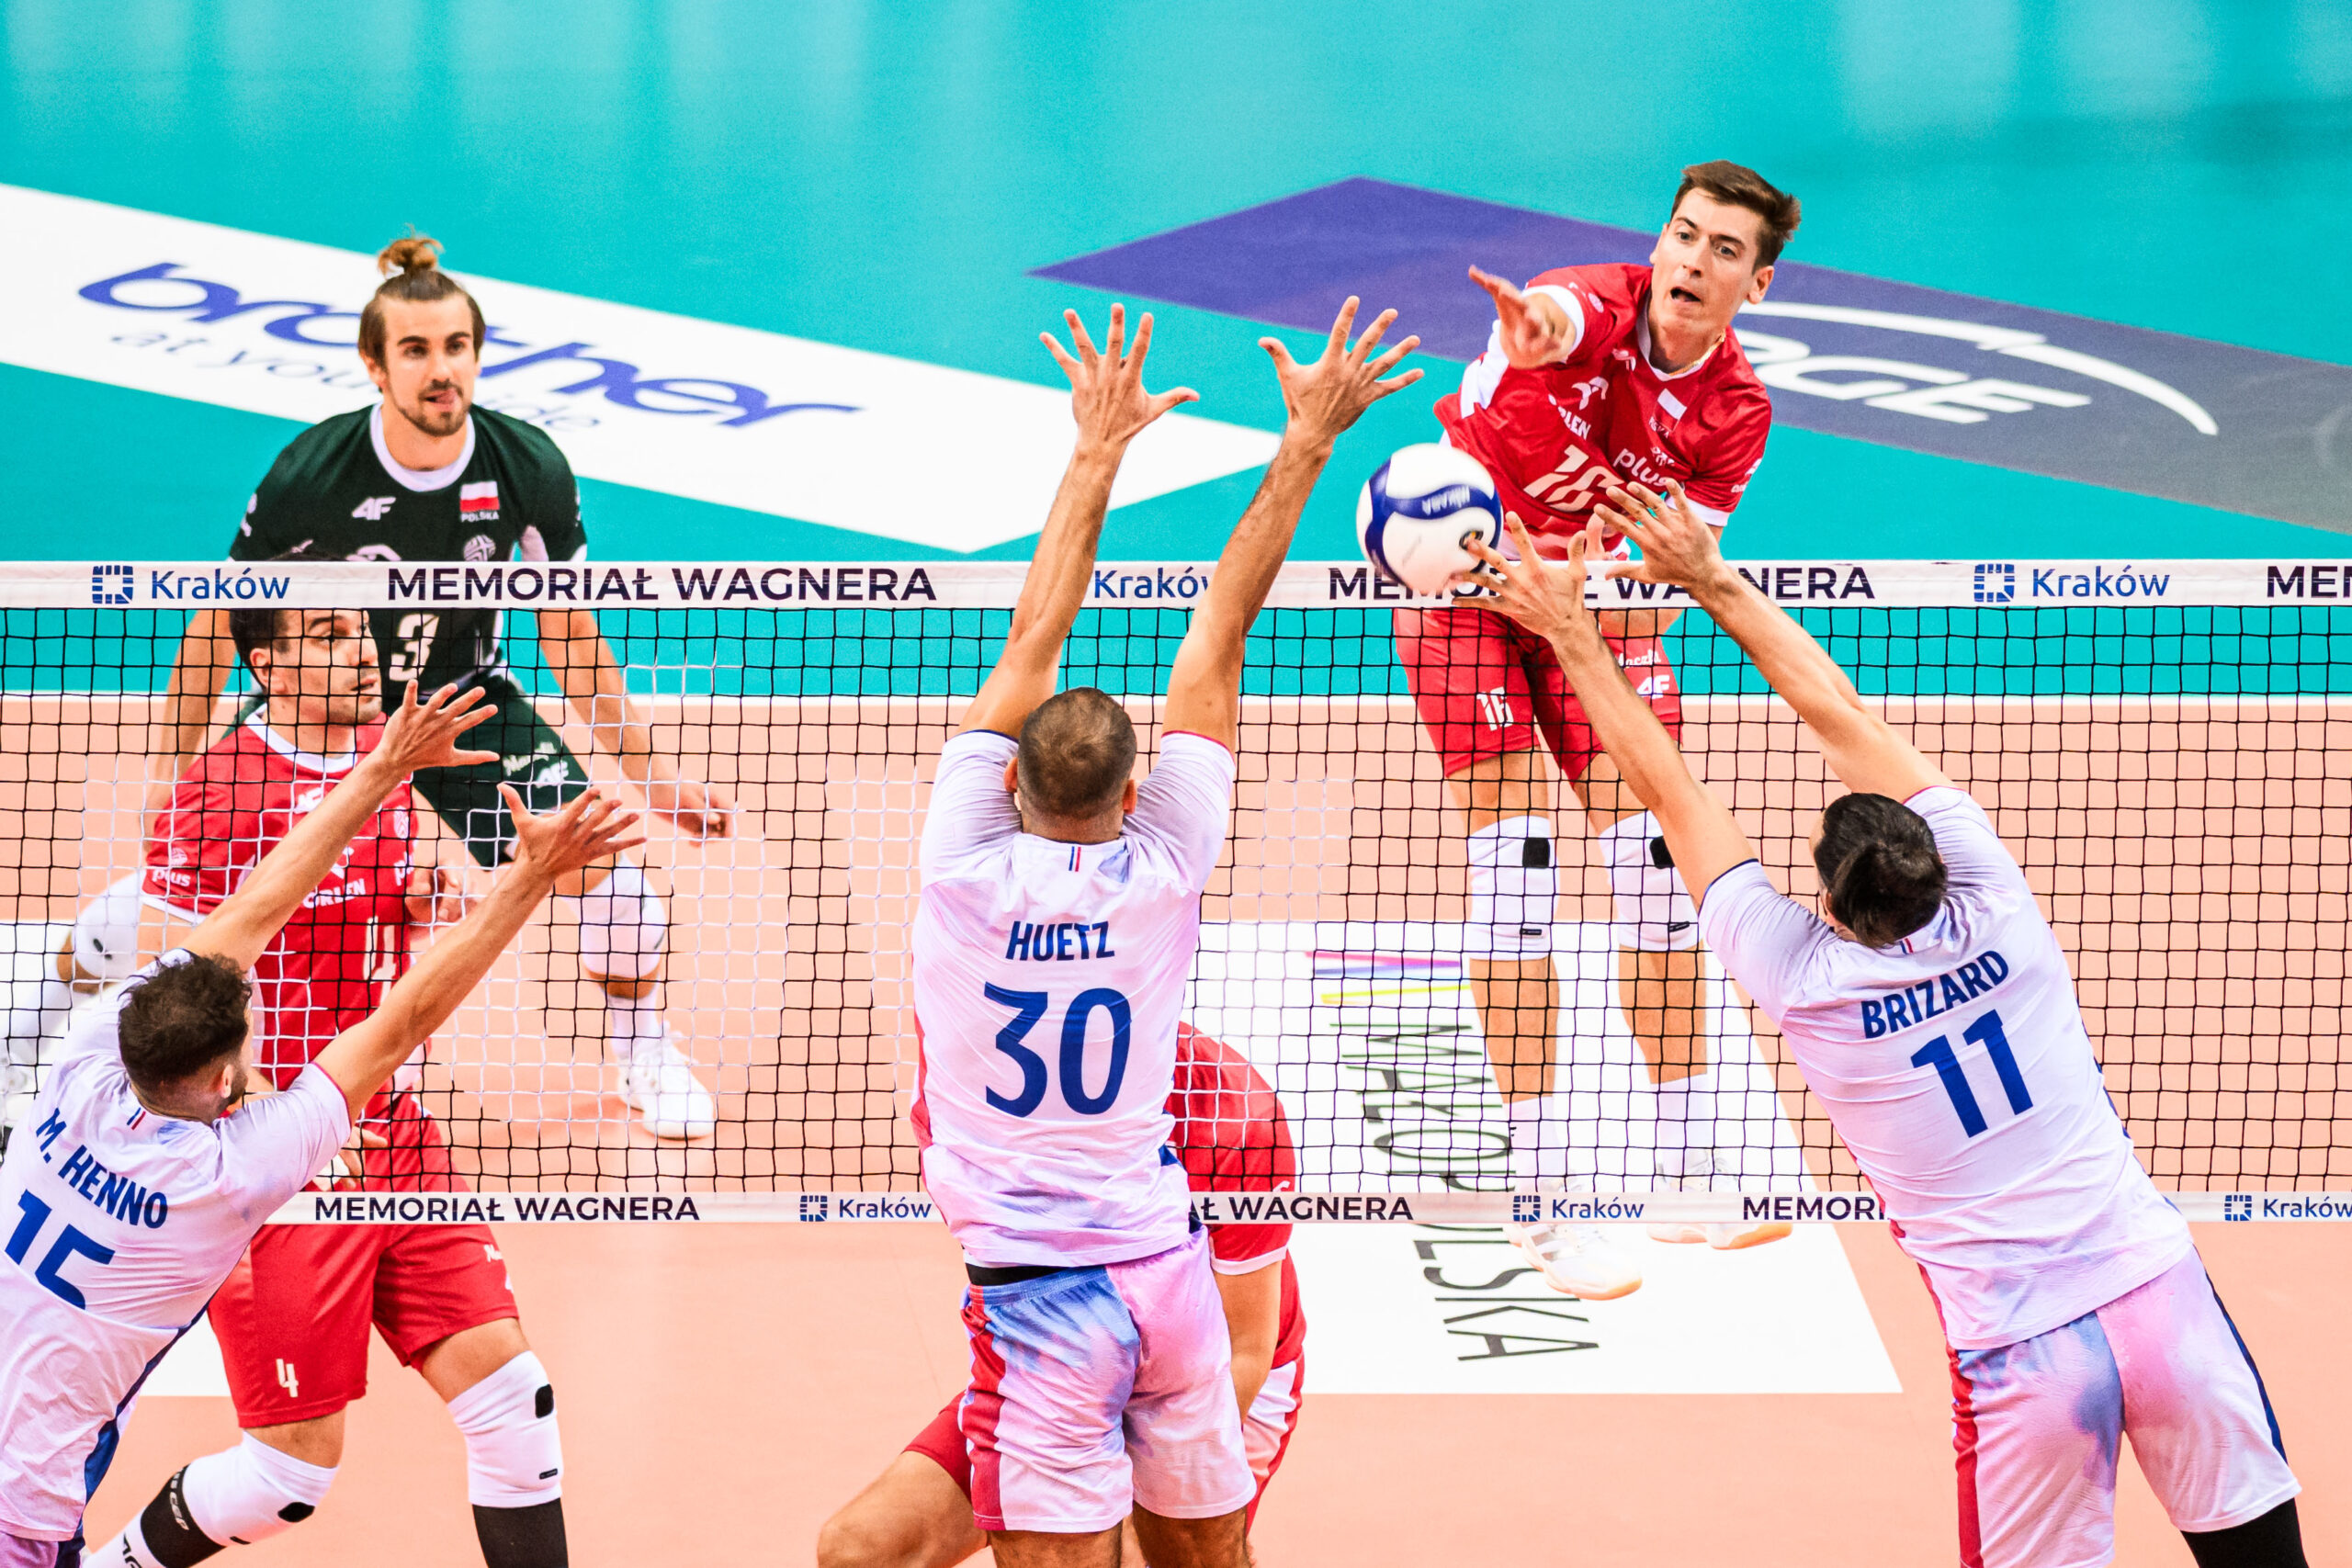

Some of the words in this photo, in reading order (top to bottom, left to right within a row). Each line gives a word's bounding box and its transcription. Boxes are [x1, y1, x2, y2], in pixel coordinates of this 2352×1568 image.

[79, 262, 862, 427] broher
[194, 350, 375, 389] you
[352, 496, 397, 521] 4F
[460, 511, 500, 524] POLSKA
[151, 569, 290, 600] Kraków
[388, 568, 659, 602] MEMORIAŁ
[672, 568, 937, 602] WAGNERA
[1614, 566, 1876, 600] WNERA
[2031, 565, 2171, 598] Kraków
[389, 613, 440, 682] 3
[1636, 674, 1670, 700] 4F
[1476, 686, 1515, 731] 16
[302, 878, 367, 908] ORLEN
[1006, 920, 1115, 961] HUETZ
[1861, 949, 2010, 1040] BRIZARD
[984, 981, 1133, 1118] 30
[1911, 1009, 2033, 1138] 11
[36, 1107, 67, 1164] M.
[58, 1145, 168, 1229] HENNO
[315, 1197, 504, 1221] MEMORIAŁ
[514, 1196, 701, 1222] WAGNERA
[839, 1196, 933, 1218] Kraków
[1227, 1196, 1415, 1222] WAGNERA
[1552, 1196, 1645, 1220] Kraków
[1743, 1196, 1885, 1221] MEMOR
[2263, 1196, 2352, 1218] Kraków
[5, 1189, 116, 1311] 15
[276, 1359, 299, 1397] 4
